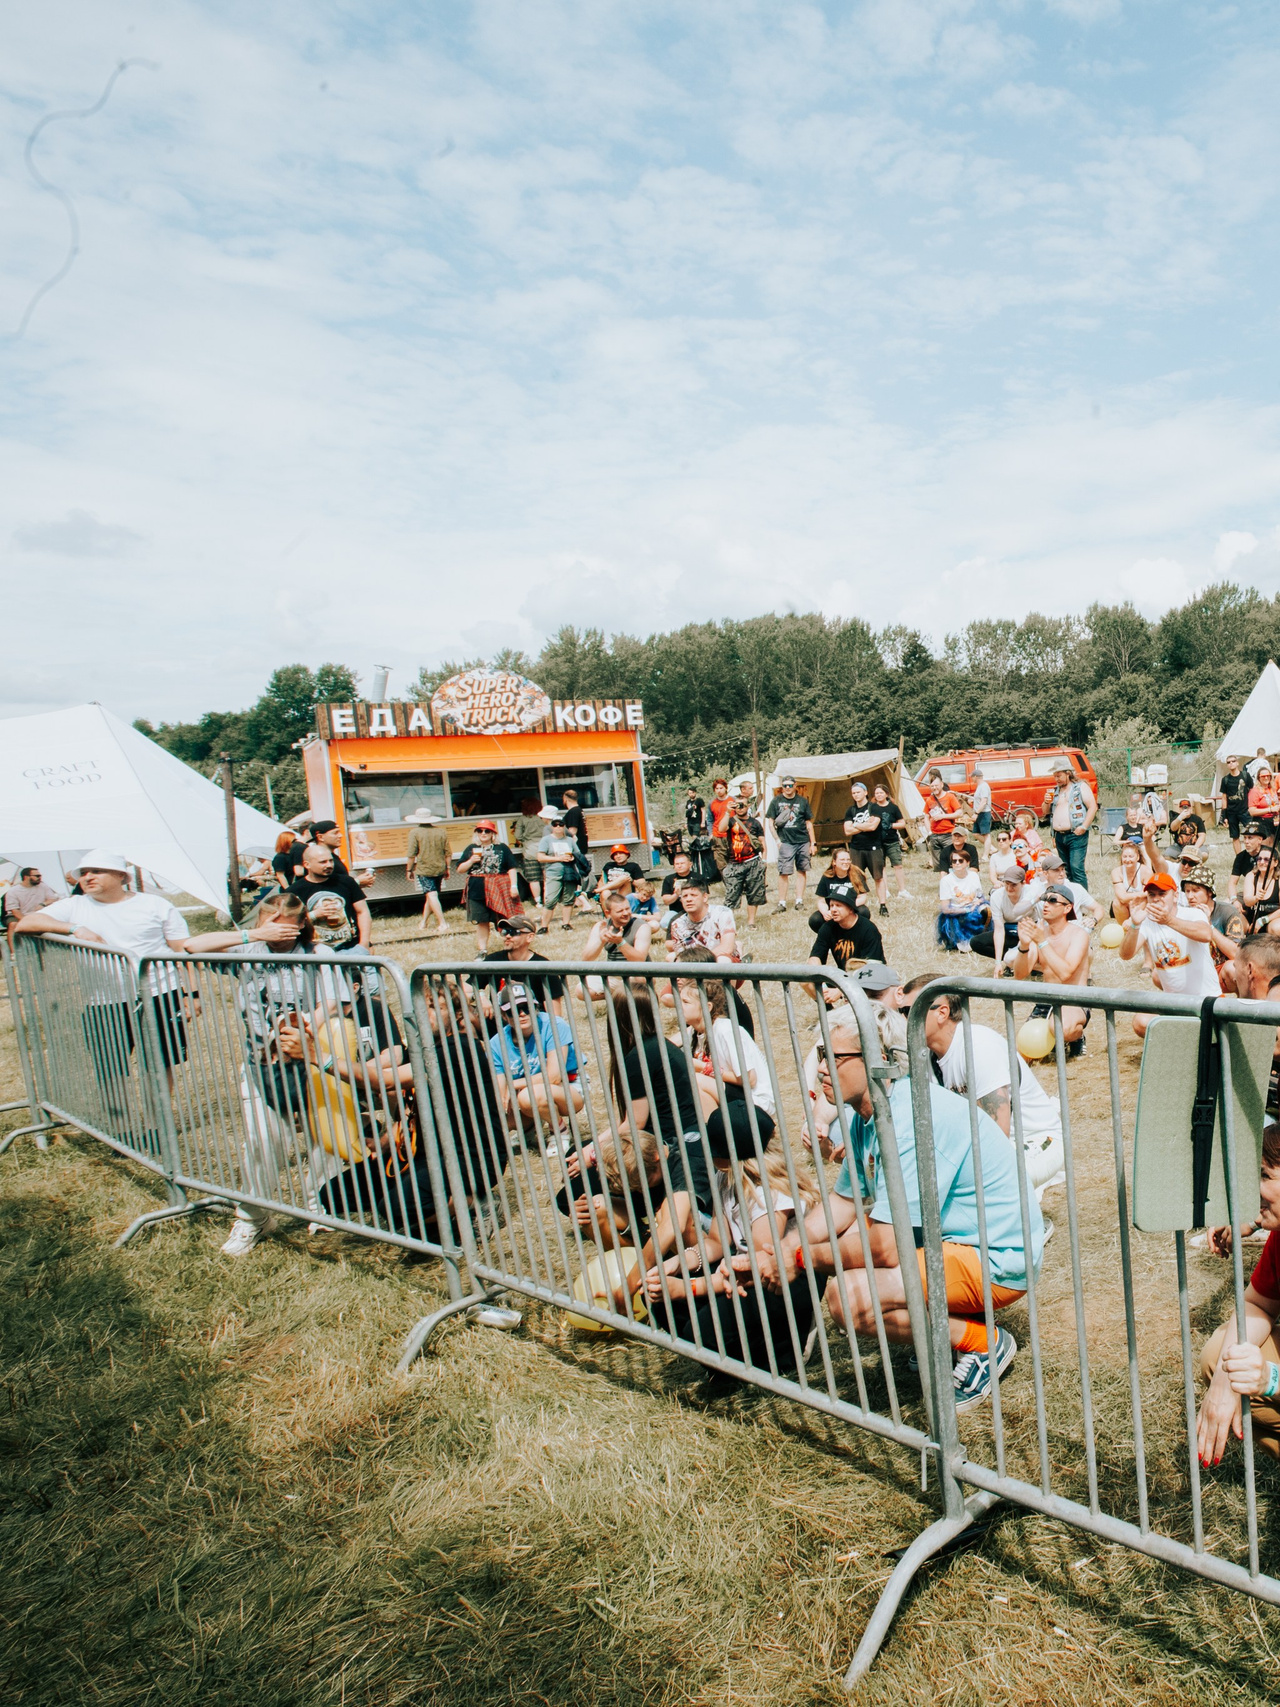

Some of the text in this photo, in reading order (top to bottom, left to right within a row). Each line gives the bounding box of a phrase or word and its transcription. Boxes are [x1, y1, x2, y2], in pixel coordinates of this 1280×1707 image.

[456, 677, 521, 698] SUPER
[467, 692, 515, 709] HERO
[331, 705, 433, 737] ЕДА
[462, 705, 526, 727] TRUCK
[554, 703, 645, 727] КОФЕ
[22, 759, 100, 778] CRAFT
[33, 773, 102, 790] FOOD
